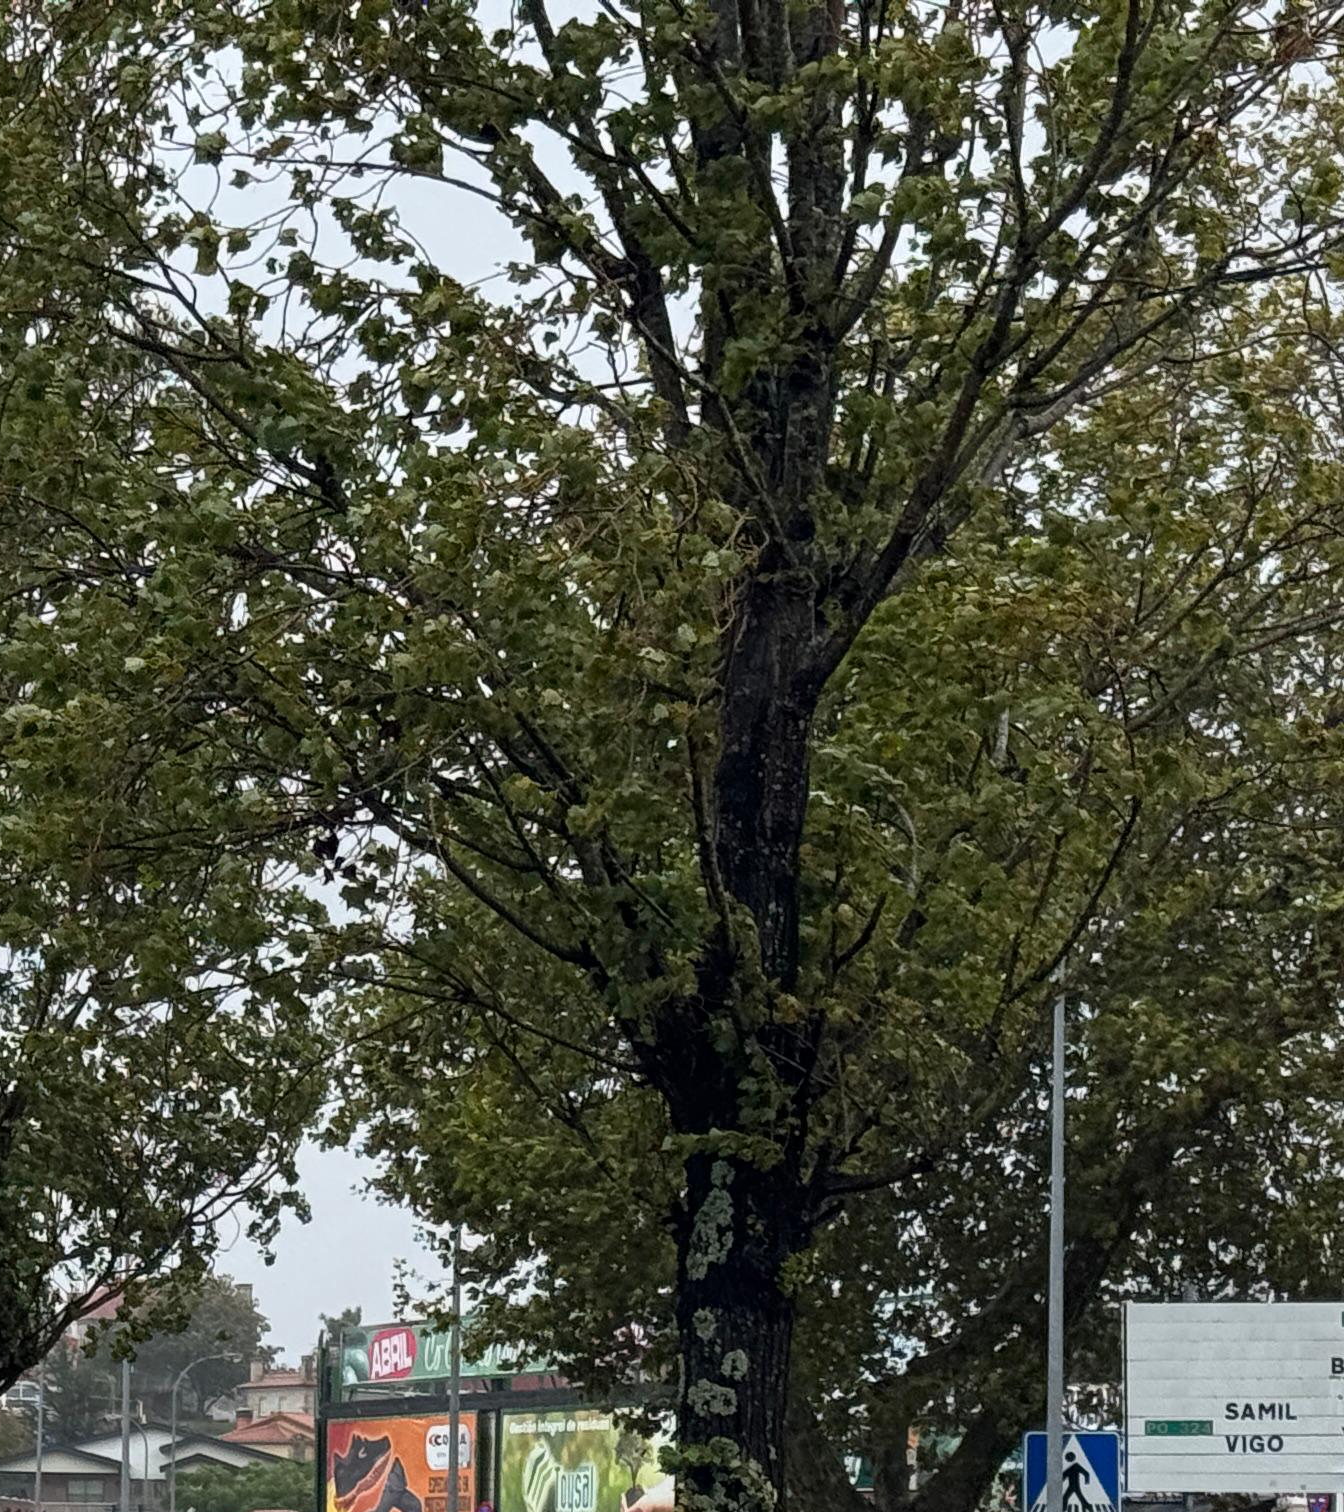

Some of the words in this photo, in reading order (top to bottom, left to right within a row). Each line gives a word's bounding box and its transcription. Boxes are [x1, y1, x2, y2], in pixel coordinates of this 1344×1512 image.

[370, 1332, 412, 1379] ABRIL
[1225, 1403, 1297, 1420] SAMIL
[1225, 1435, 1284, 1452] VIGO
